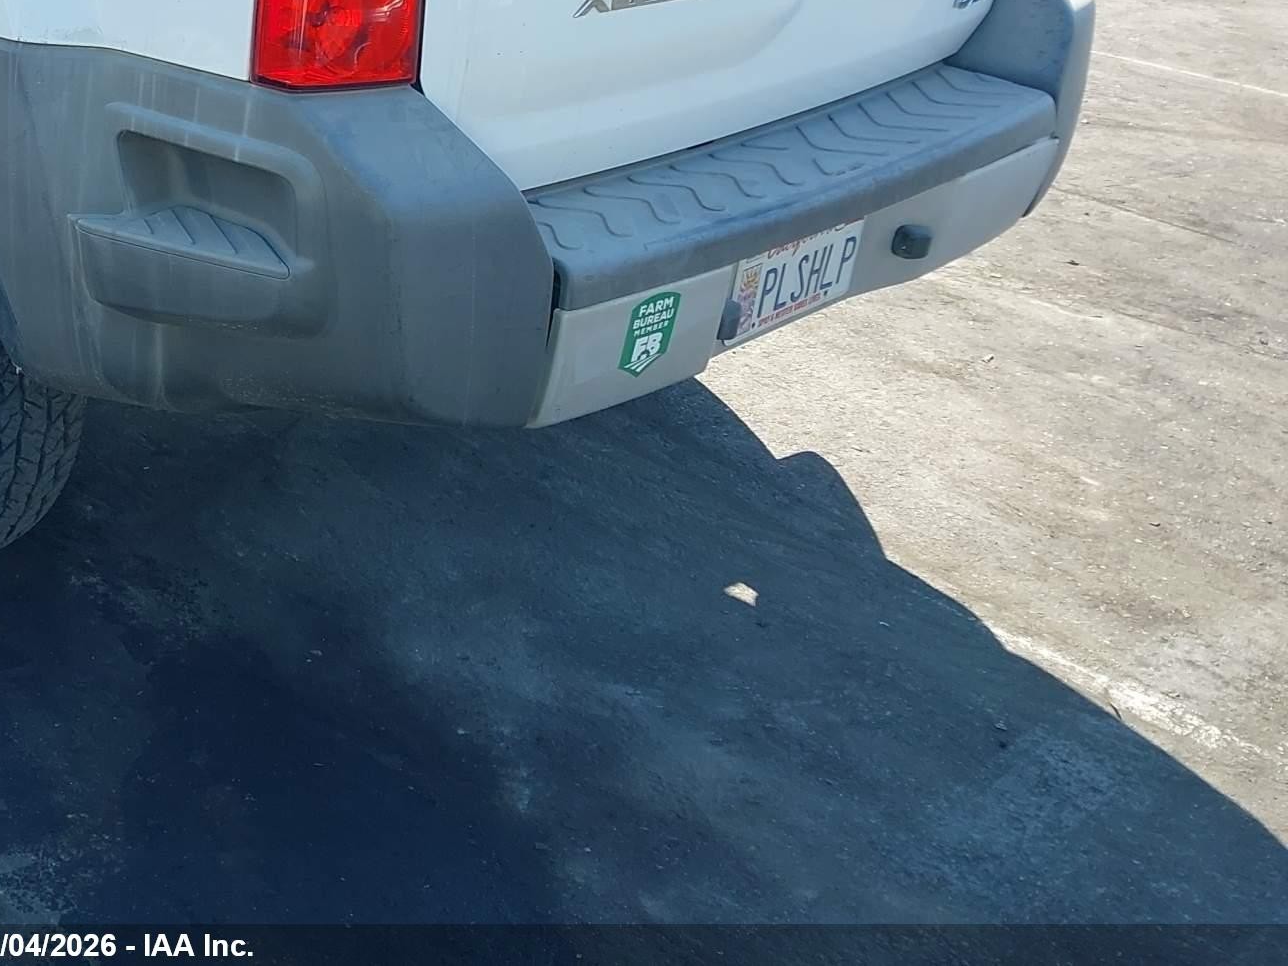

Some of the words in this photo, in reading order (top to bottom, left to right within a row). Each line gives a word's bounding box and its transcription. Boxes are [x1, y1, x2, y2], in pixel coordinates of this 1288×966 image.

[756, 235, 858, 319] PLSHLP
[639, 296, 675, 317] FARM
[632, 308, 675, 330] BUREAU
[633, 320, 669, 337] MEMBER
